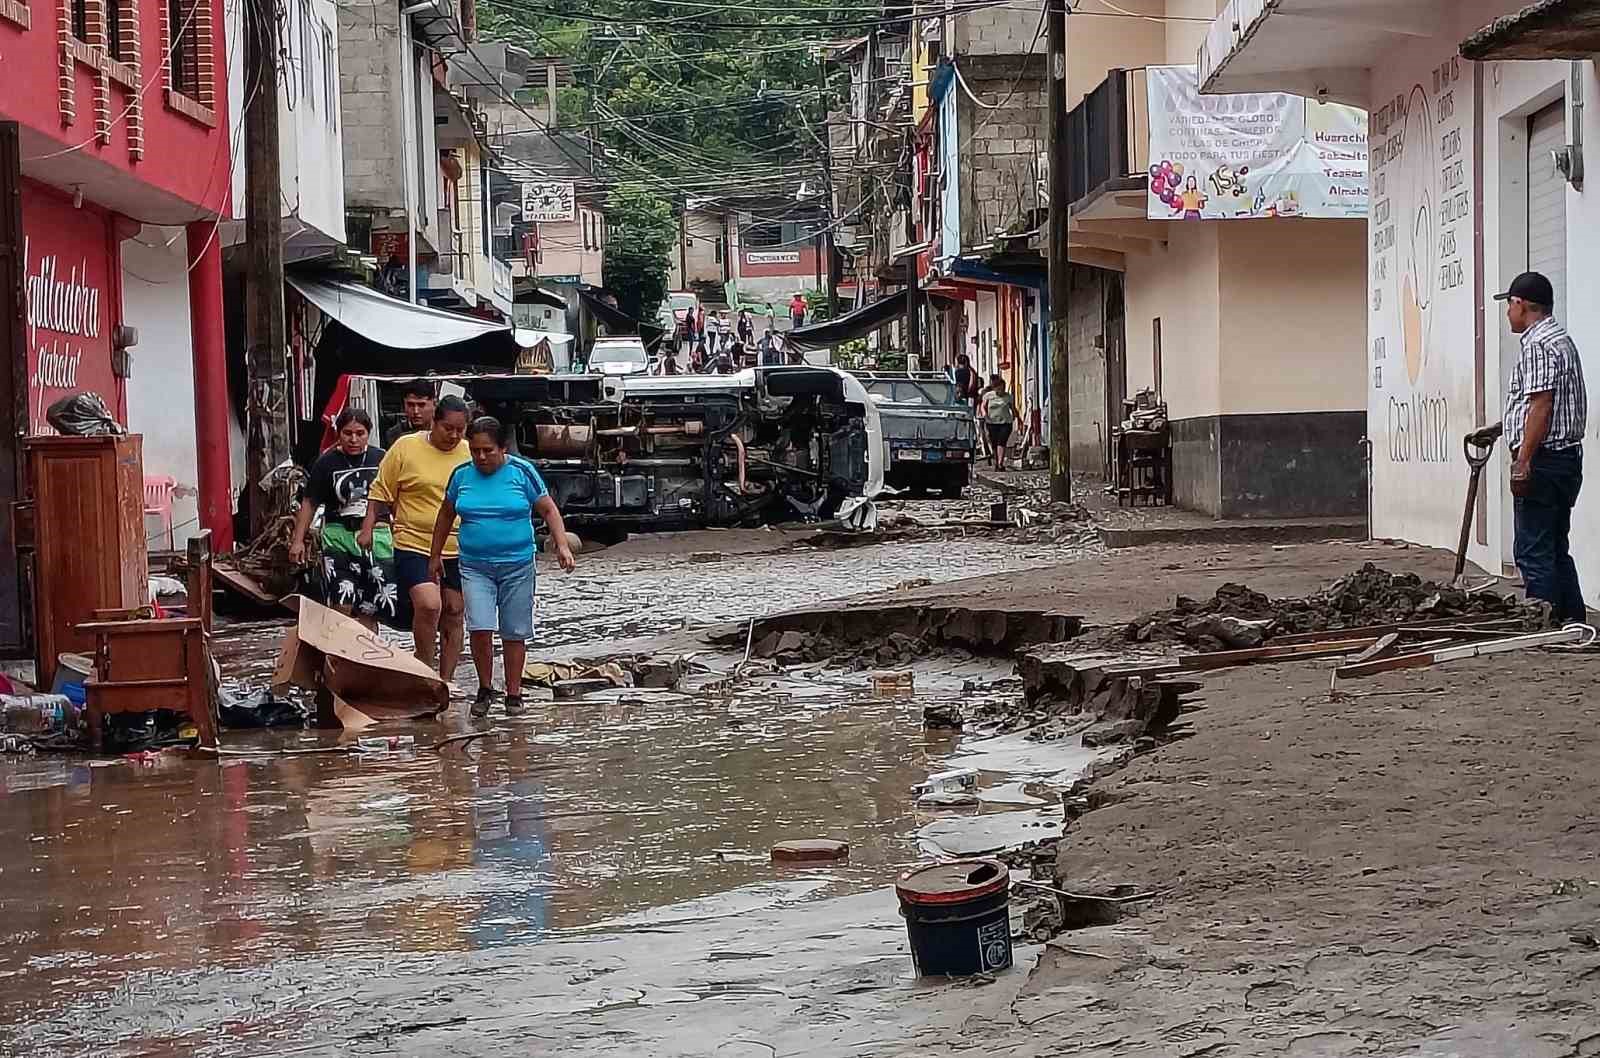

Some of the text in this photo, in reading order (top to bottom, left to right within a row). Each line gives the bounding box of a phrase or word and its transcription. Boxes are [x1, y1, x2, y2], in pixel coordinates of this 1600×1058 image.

[1315, 131, 1368, 143] Huarachi
[1215, 138, 1229, 147] DE
[1169, 151, 1198, 160] TODO
[1200, 151, 1227, 160] PARA
[24, 235, 100, 349] lquiladora
